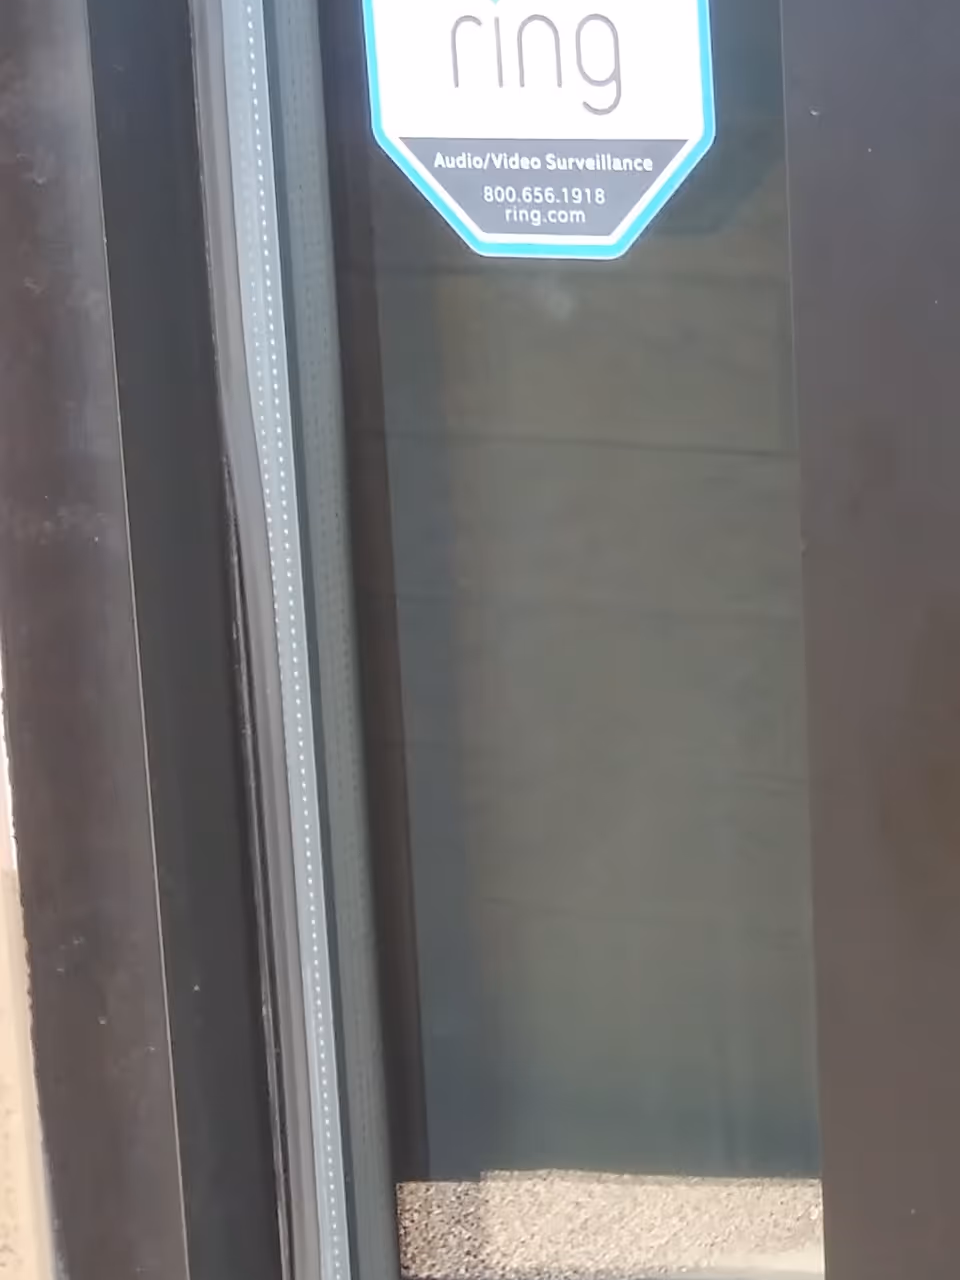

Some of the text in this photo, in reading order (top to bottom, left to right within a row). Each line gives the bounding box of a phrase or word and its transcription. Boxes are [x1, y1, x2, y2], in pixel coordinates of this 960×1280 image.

[433, 152, 654, 173] Audio/Video Surveillance
[483, 186, 606, 204] 800.656.1918
[504, 205, 586, 225] ring.com
